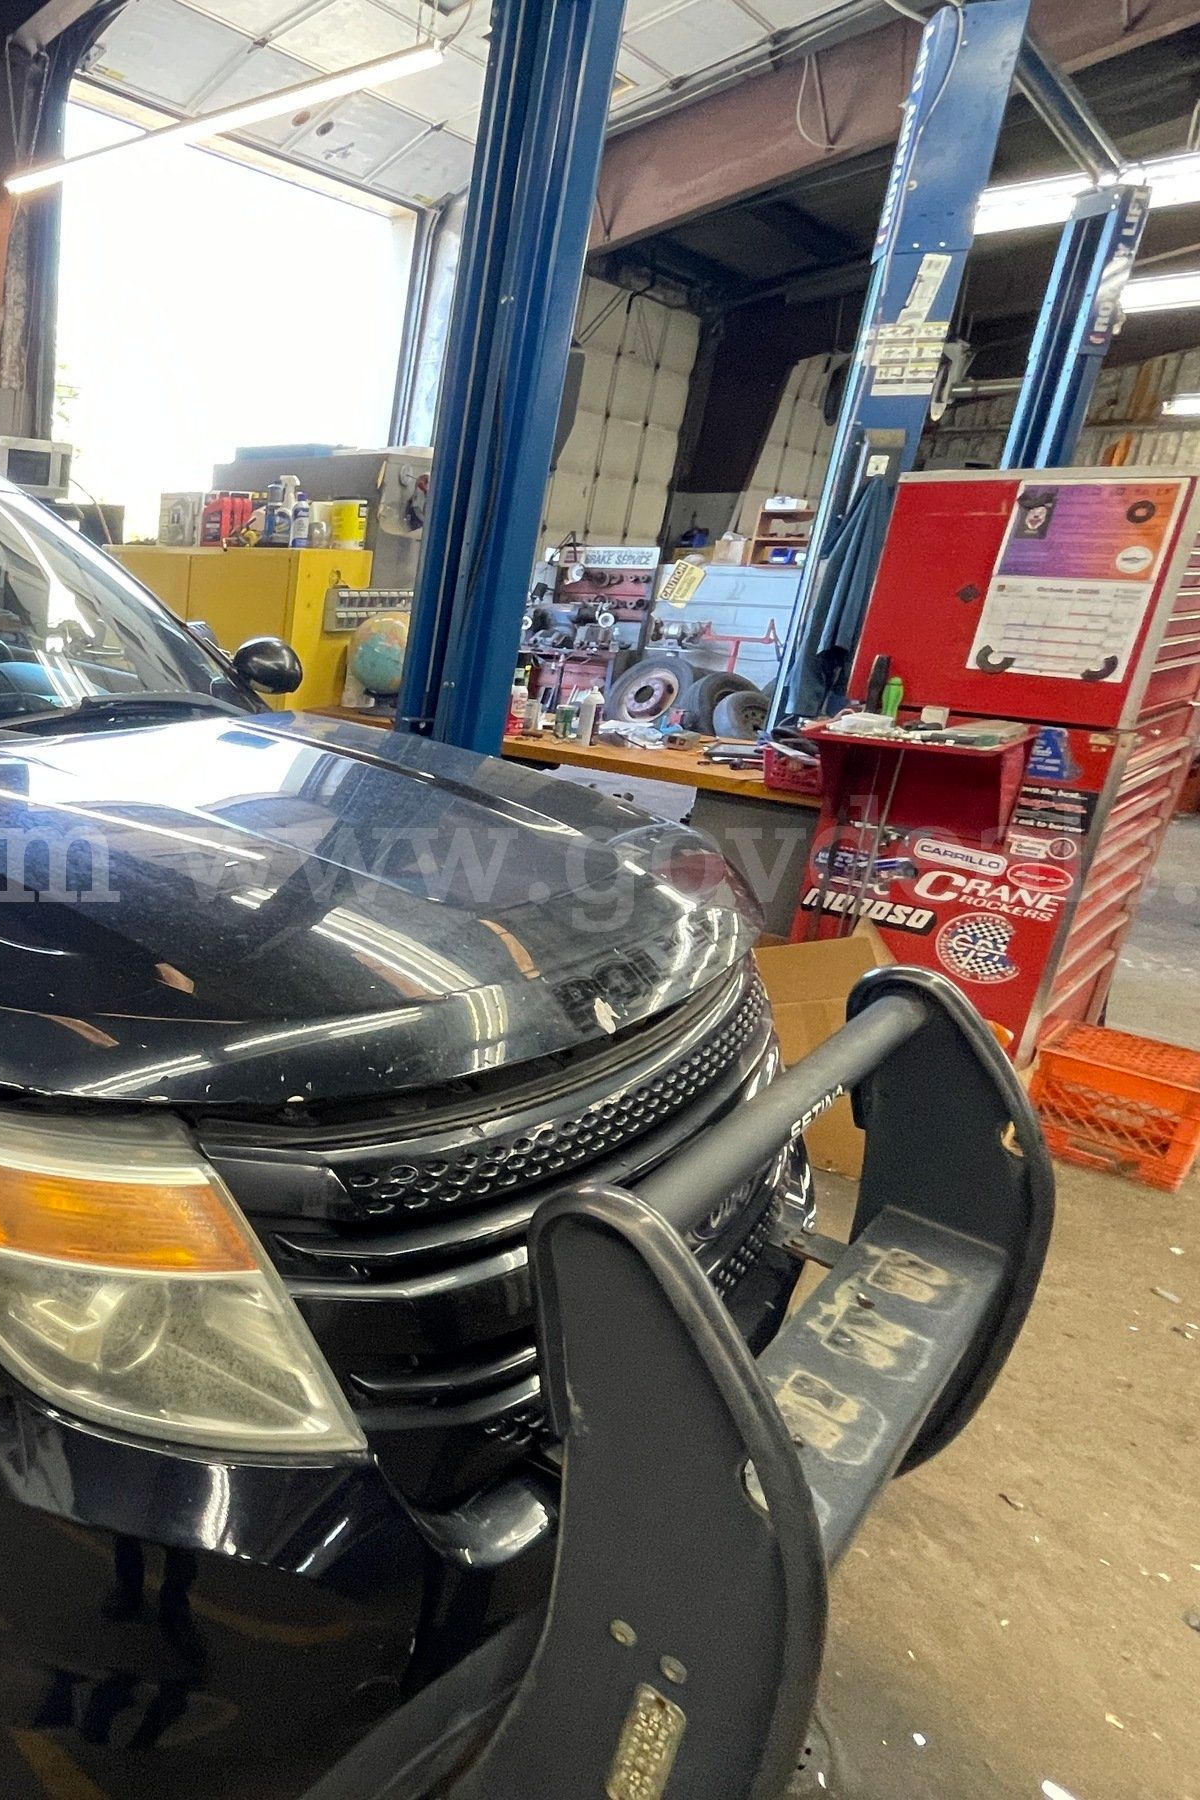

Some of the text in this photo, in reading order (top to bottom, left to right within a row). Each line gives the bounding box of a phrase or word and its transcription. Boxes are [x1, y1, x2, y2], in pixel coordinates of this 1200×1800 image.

[1122, 187, 1150, 236] LIFT
[585, 554, 651, 566] BRAKE SERVICE
[661, 562, 688, 600] CAUTION
[919, 843, 1001, 870] CARRILLO
[913, 871, 1066, 914] CRANE
[958, 894, 1055, 922] ROCKERS
